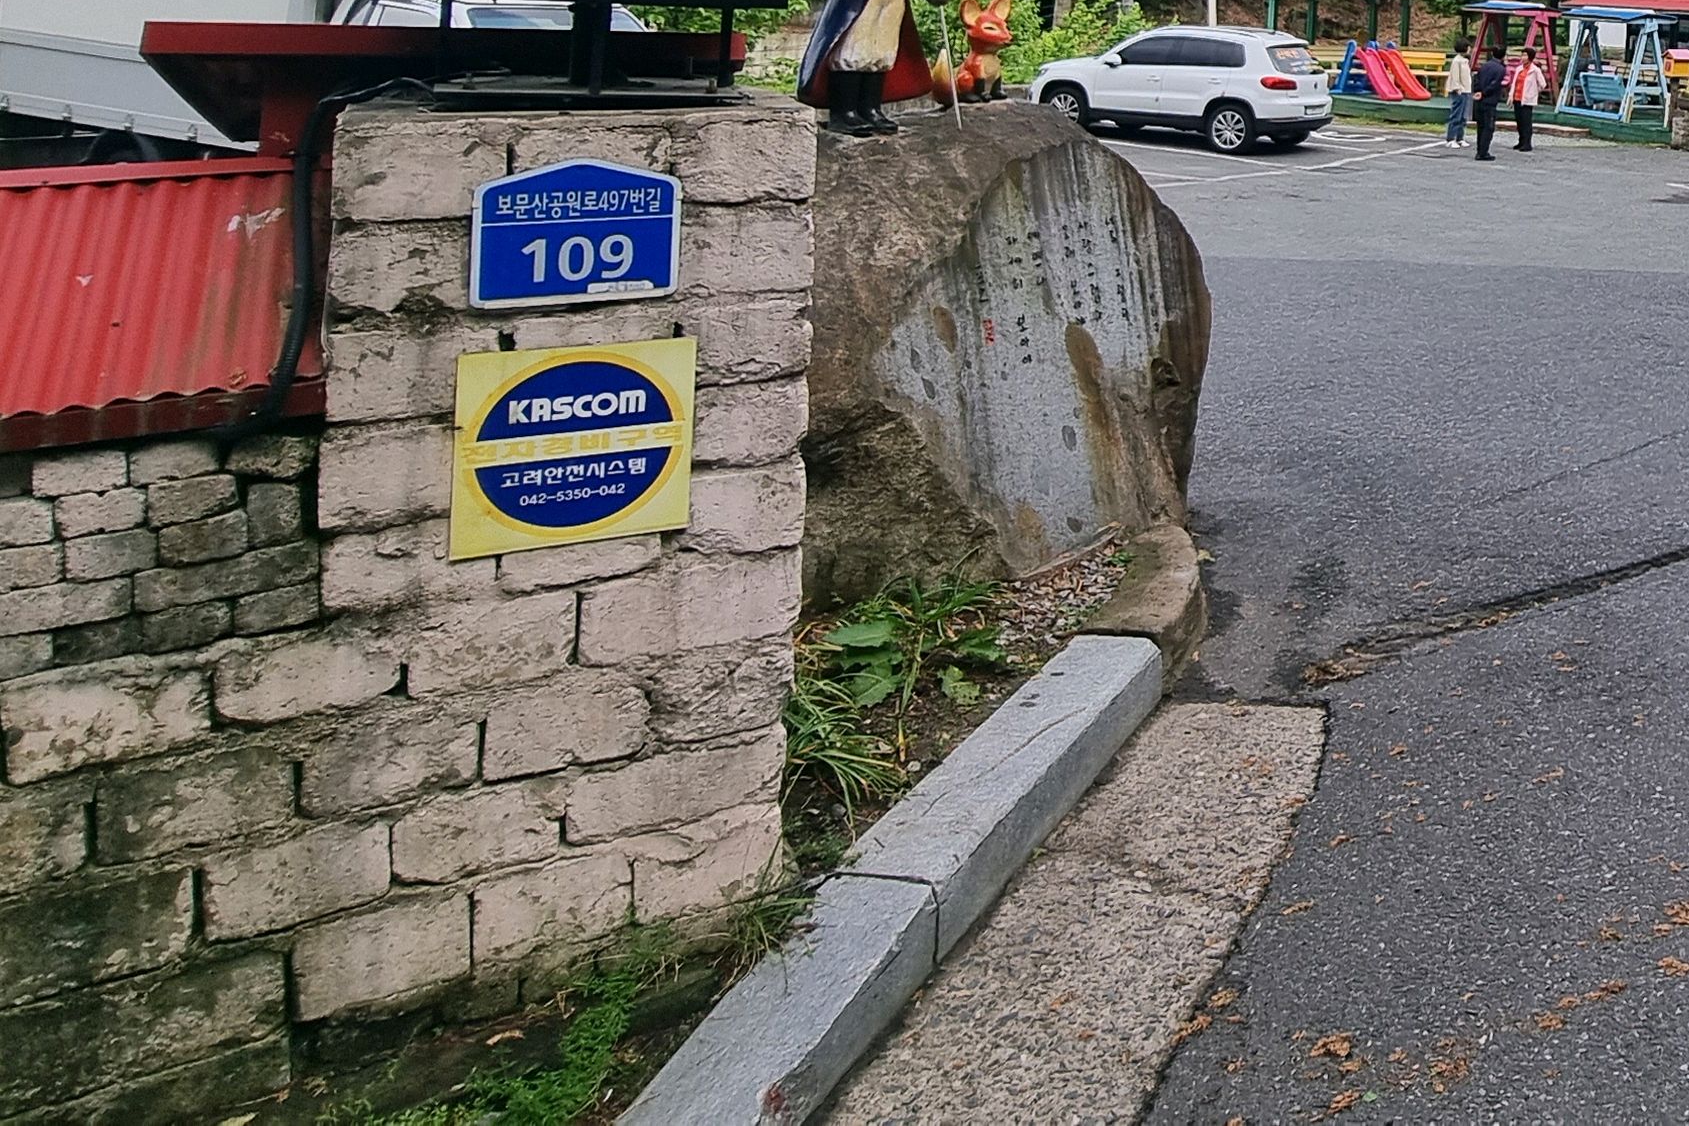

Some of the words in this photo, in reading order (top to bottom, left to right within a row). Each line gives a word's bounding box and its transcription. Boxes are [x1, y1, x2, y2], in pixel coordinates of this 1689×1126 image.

[495, 187, 662, 219] 보문산공원로497번길
[521, 234, 634, 283] 109
[508, 389, 647, 425] KASCOM
[501, 458, 647, 488] 고려안전시스템
[519, 483, 626, 506] 042-5350-042
